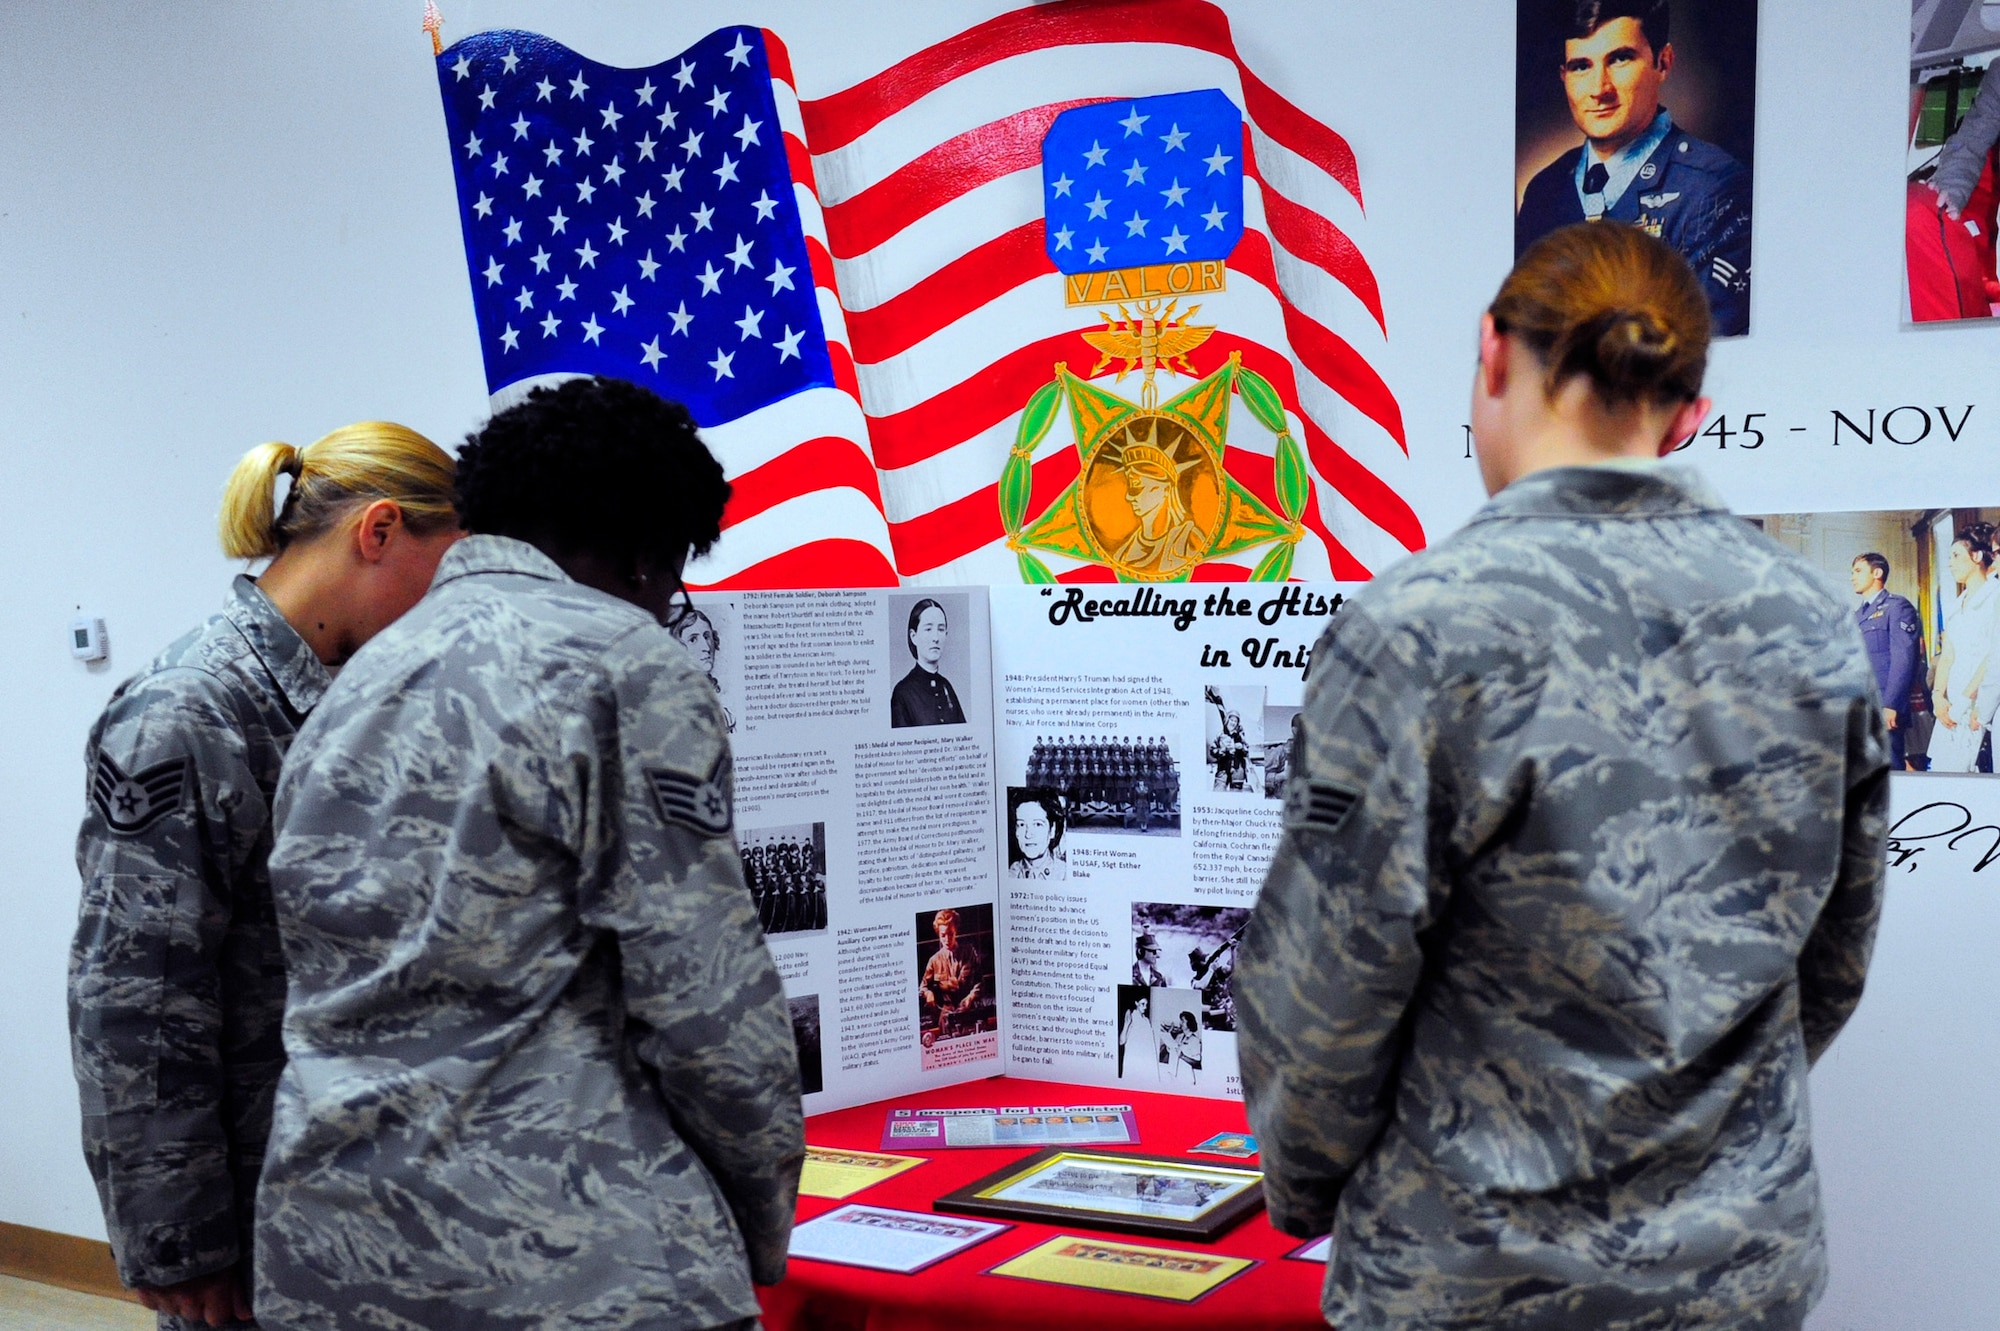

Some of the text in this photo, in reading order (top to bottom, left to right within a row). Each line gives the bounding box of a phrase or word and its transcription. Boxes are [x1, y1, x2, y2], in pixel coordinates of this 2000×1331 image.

[1643, 165, 1655, 175] US
[1070, 261, 1222, 302] VALOR
[1673, 404, 1976, 452] 45 NOV
[1204, 586, 1251, 616] the
[1258, 586, 1344, 626] Hist
[1200, 644, 1232, 668] in
[1058, 675, 1078, 684] Harry
[1128, 676, 1150, 684] signed
[1091, 687, 1128, 695] Integration
[1006, 697, 1044, 706] establishing
[1090, 698, 1108, 706] place
[1150, 699, 1172, 707] (other
[1065, 709, 1090, 718] already
[1092, 710, 1133, 718] permanent)
[1157, 710, 1177, 719] Army,
[1098, 720, 1118, 729] Corps
[1214, 807, 1252, 817] Jacqueline
[1193, 818, 1201, 827] by
[1202, 818, 1242, 828] then-Major
[1193, 829, 1219, 839] lifelong
[1225, 853, 1244, 863] Royal
[1080, 860, 1100, 868] USAF,
[1102, 861, 1116, 870] SSgt
[1224, 865, 1241, 874] mph,
[1193, 874, 1220, 882] barrier.
[1207, 886, 1223, 895] pilot
[1225, 887, 1244, 897] living
[1046, 894, 1065, 904] policy
[1059, 905, 1086, 913] advance
[1041, 916, 1067, 924] position
[1010, 924, 1033, 932] Armed
[1072, 928, 1100, 936] decision
[1078, 940, 1090, 949] rely
[1054, 949, 1077, 959] military
[1011, 957, 1028, 966] (AVF)
[1056, 961, 1088, 970] proposed
[1090, 962, 1108, 971] Equal
[1011, 967, 1031, 977] Rights
[1032, 969, 1073, 978] Amendment
[926, 1046, 953, 1054] WOMAN'S
